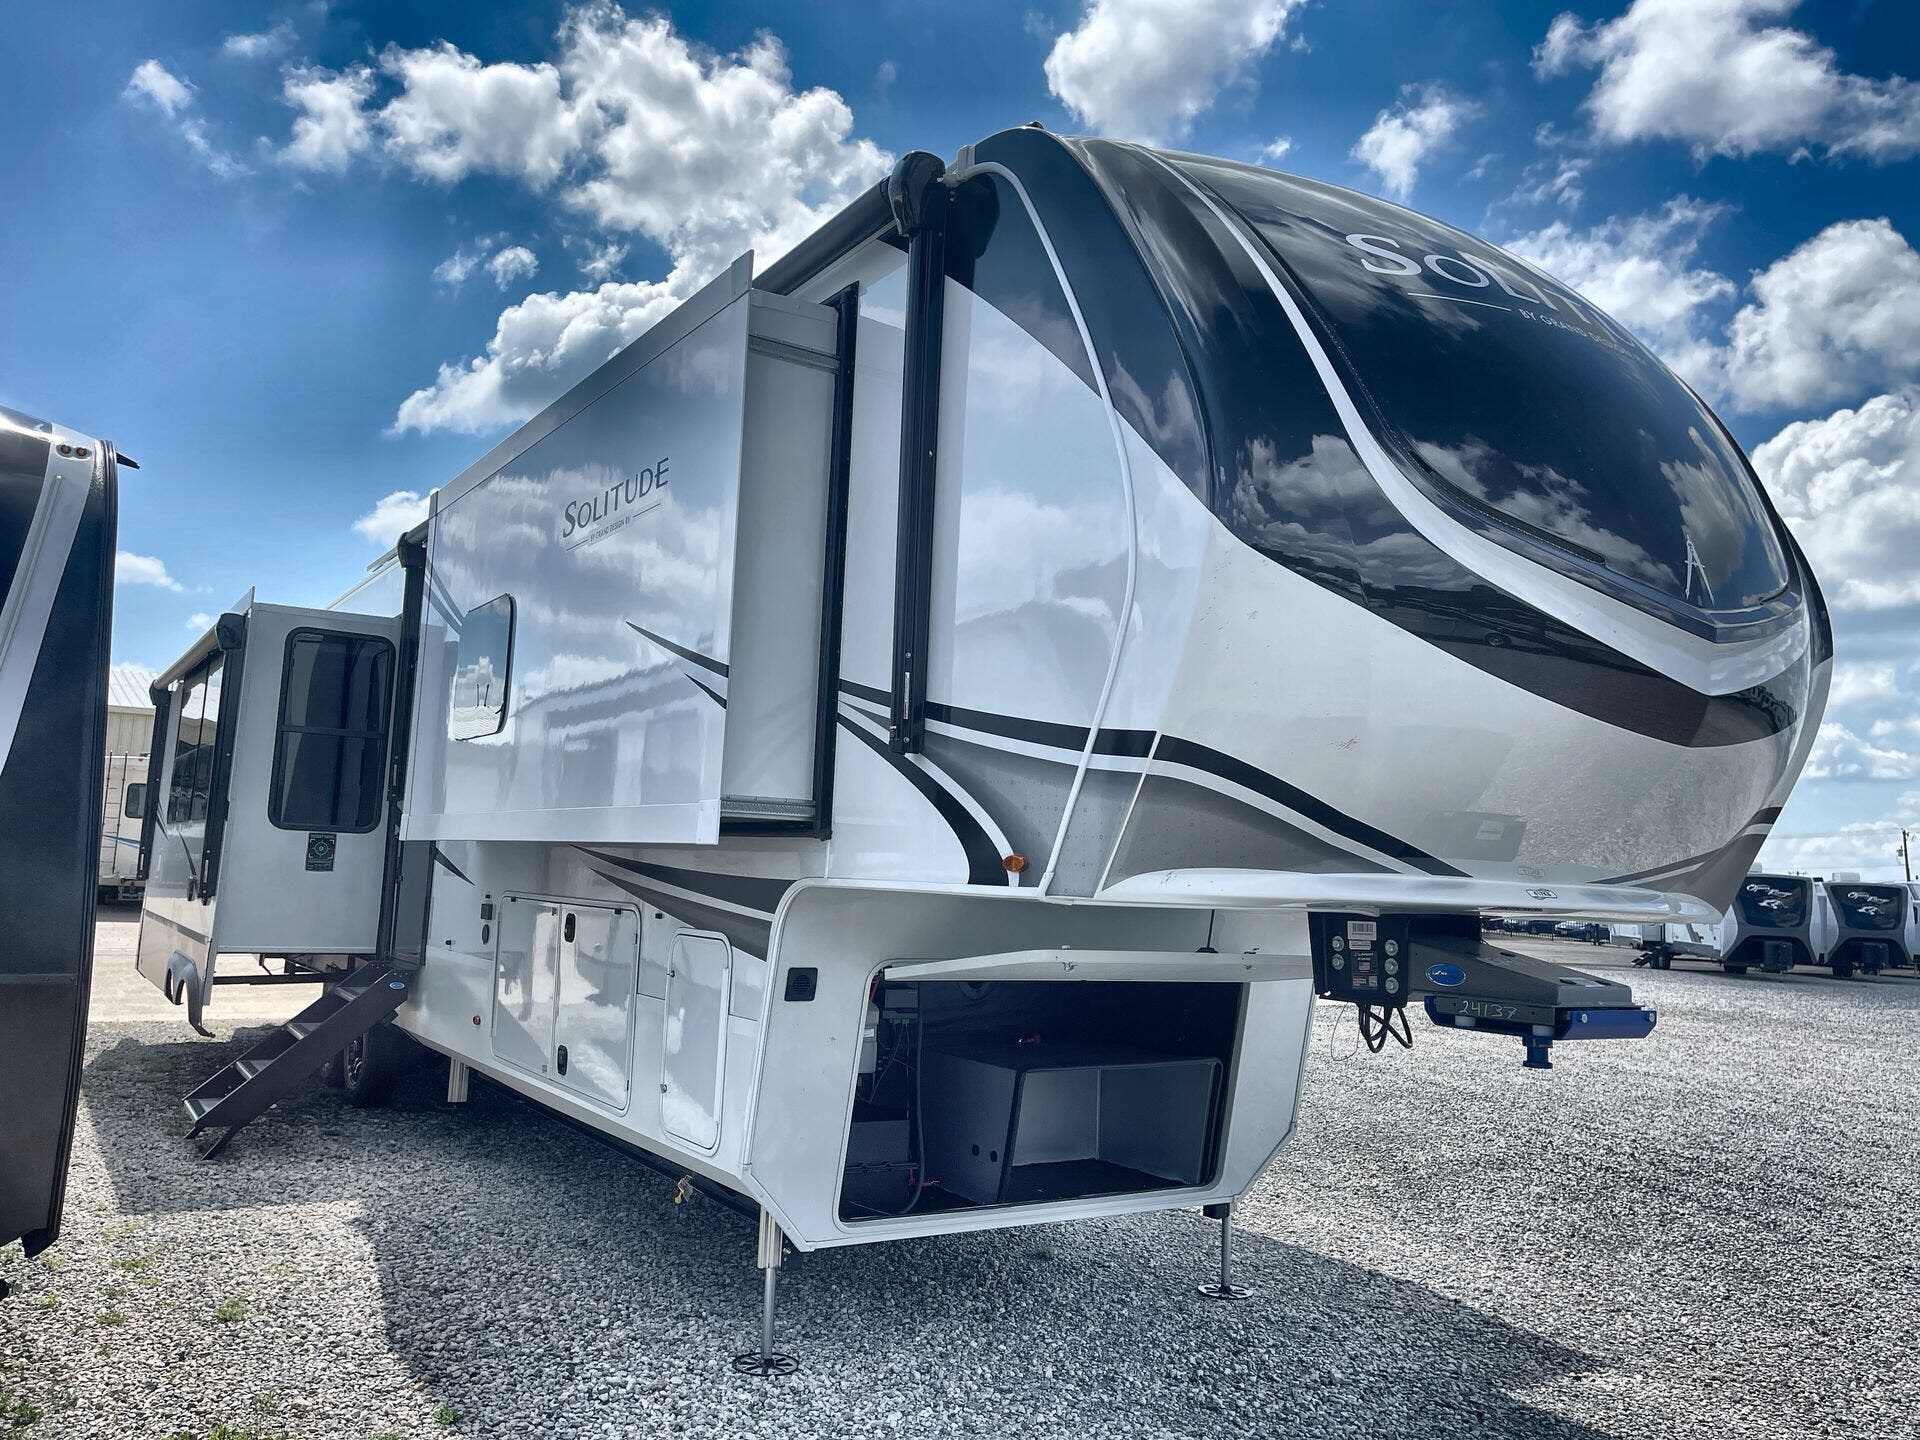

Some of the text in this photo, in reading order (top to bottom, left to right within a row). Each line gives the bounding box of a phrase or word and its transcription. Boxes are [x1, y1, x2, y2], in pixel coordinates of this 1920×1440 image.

[1519, 308, 1537, 321] BY
[562, 457, 670, 538] SOLITUDE
[1459, 1000, 1518, 1020] 24137
